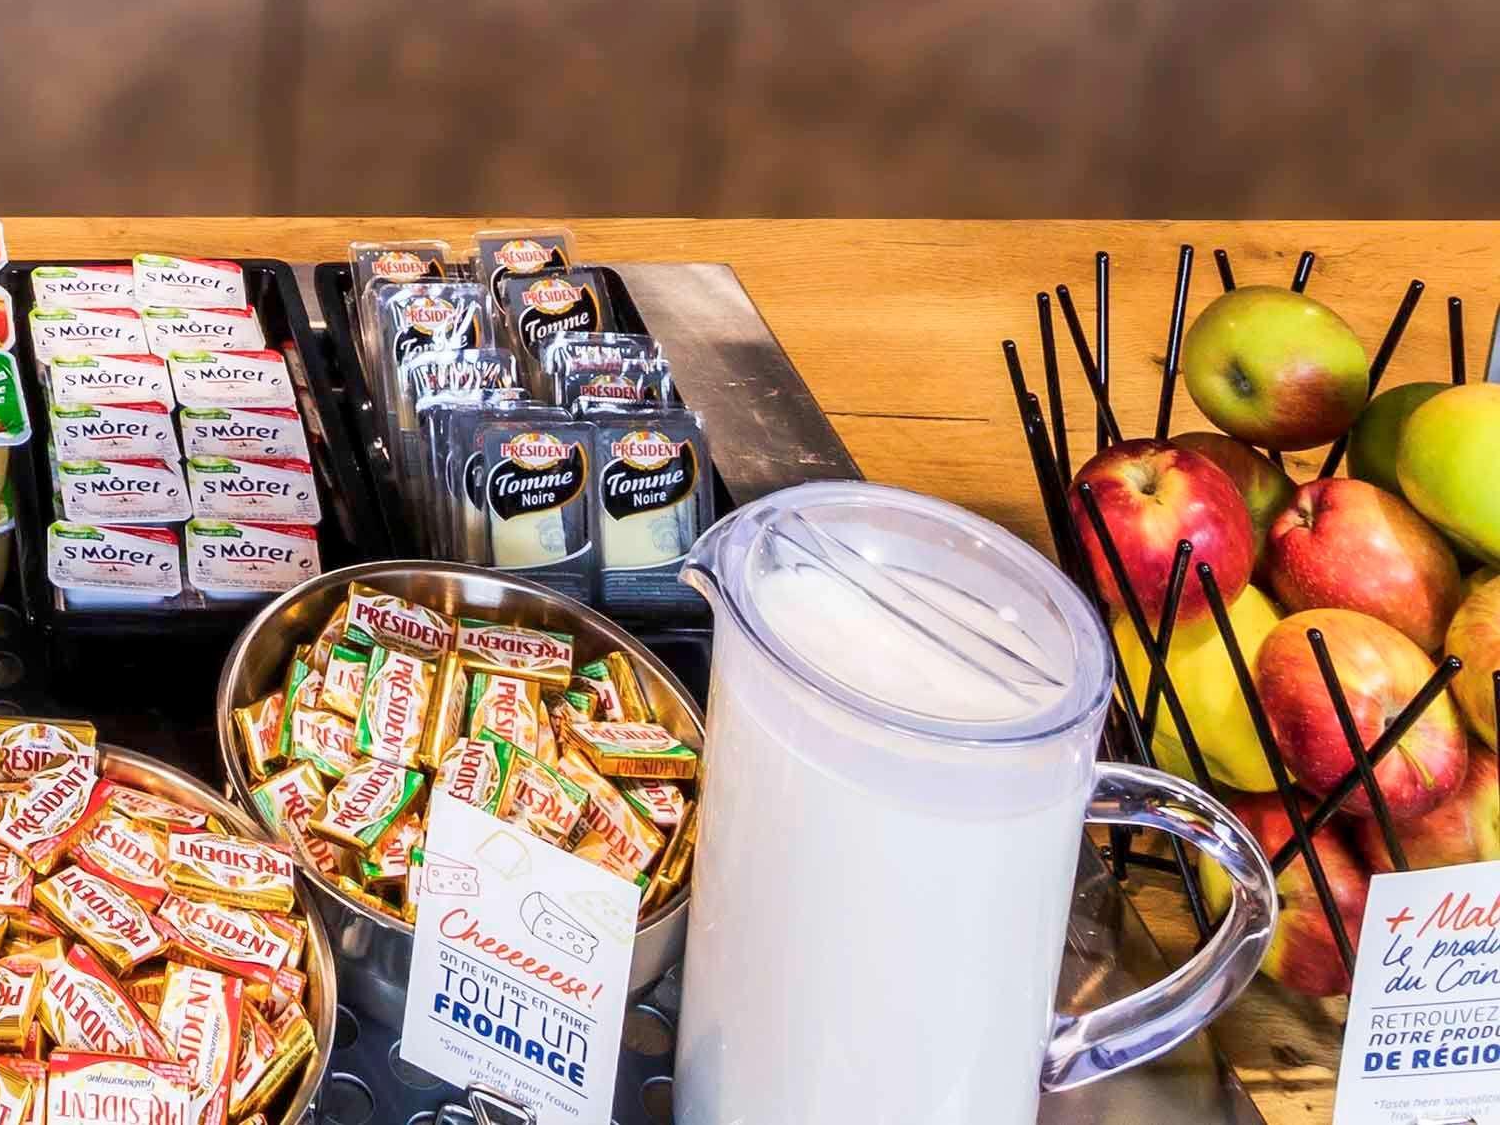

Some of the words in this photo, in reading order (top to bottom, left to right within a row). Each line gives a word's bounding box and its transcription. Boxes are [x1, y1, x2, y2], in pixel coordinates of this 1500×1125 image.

[522, 286, 583, 305] PRÉSIDENT
[525, 310, 590, 341] Tomme
[500, 441, 572, 459] PRÉSIDENT
[611, 440, 681, 458] PRÉSIDENT
[495, 470, 573, 497] Tomme
[606, 469, 684, 496] Tomme
[521, 490, 556, 507] Noire
[633, 490, 668, 508] Noire
[1382, 934, 1414, 967] Le
[439, 950, 458, 967] ON
[461, 960, 478, 977] NE
[481, 969, 498, 987] VA
[502, 978, 527, 1001] PAS
[532, 993, 549, 1012] EN
[552, 1004, 591, 1035] FAIRE
[1384, 964, 1428, 994] du
[439, 964, 528, 1029] TOUT
[541, 1017, 588, 1063] UN
[1370, 1005, 1499, 1030] RETROUVEZ
[433, 992, 586, 1088] FROMAGE
[1368, 1029, 1435, 1046] NOTRE
[1364, 1051, 1402, 1072] DE
[484, 1061, 511, 1081] Turn
[514, 1075, 541, 1097] your
[544, 1090, 580, 1116] frown
